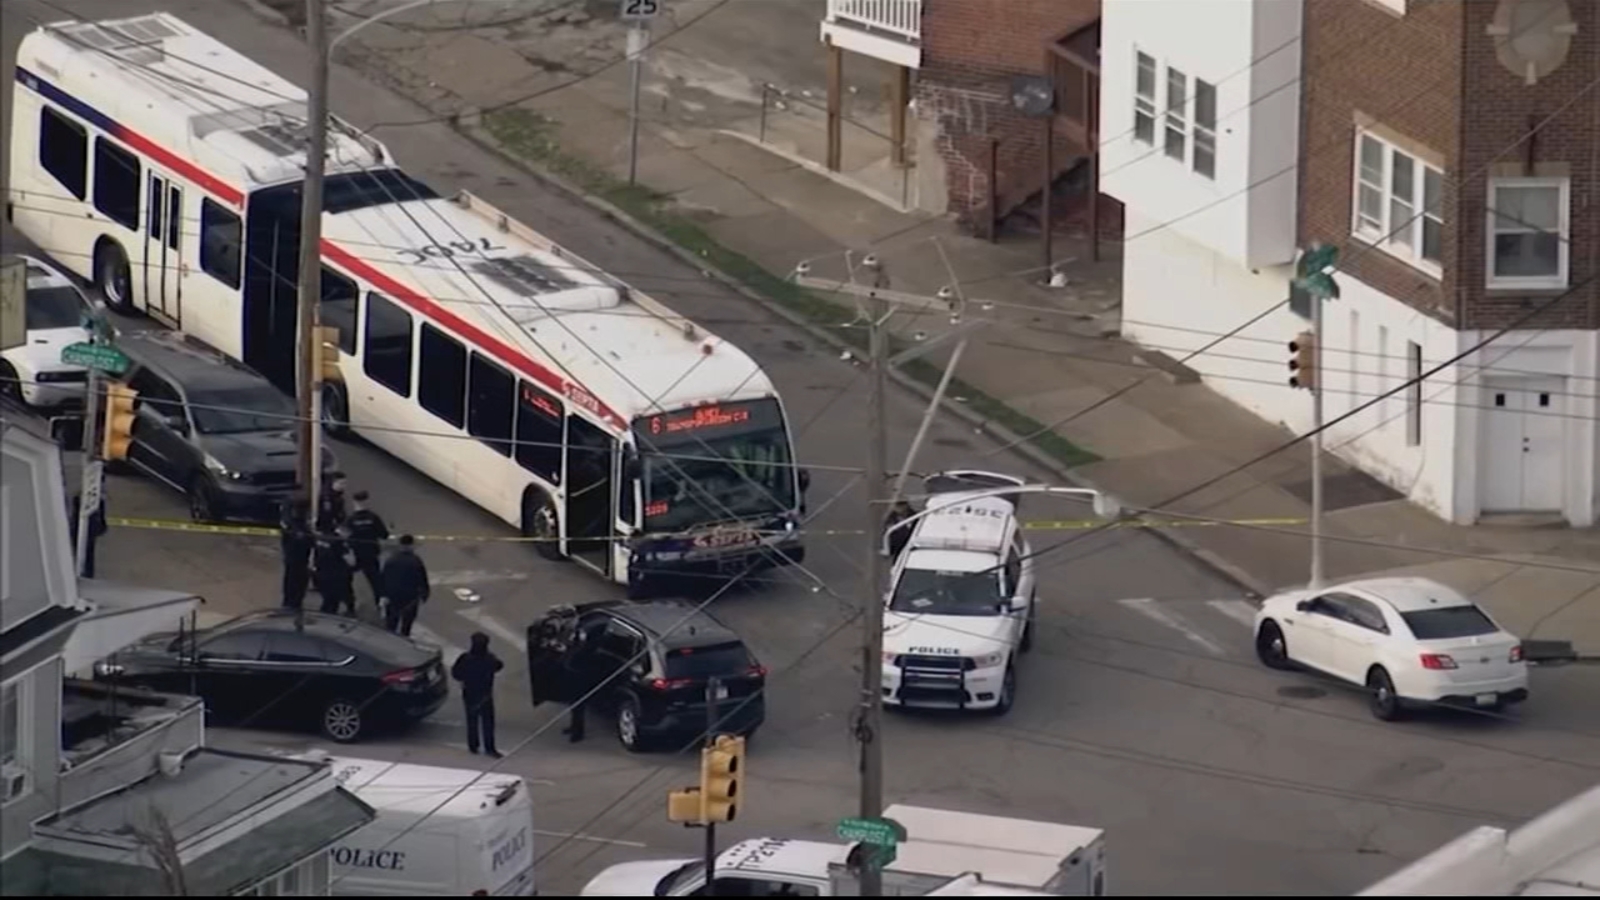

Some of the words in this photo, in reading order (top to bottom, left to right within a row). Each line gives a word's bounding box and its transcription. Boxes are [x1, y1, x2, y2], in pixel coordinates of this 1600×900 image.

[626, 0, 657, 15] 25
[651, 416, 661, 434] 6
[909, 646, 960, 655] POLICE
